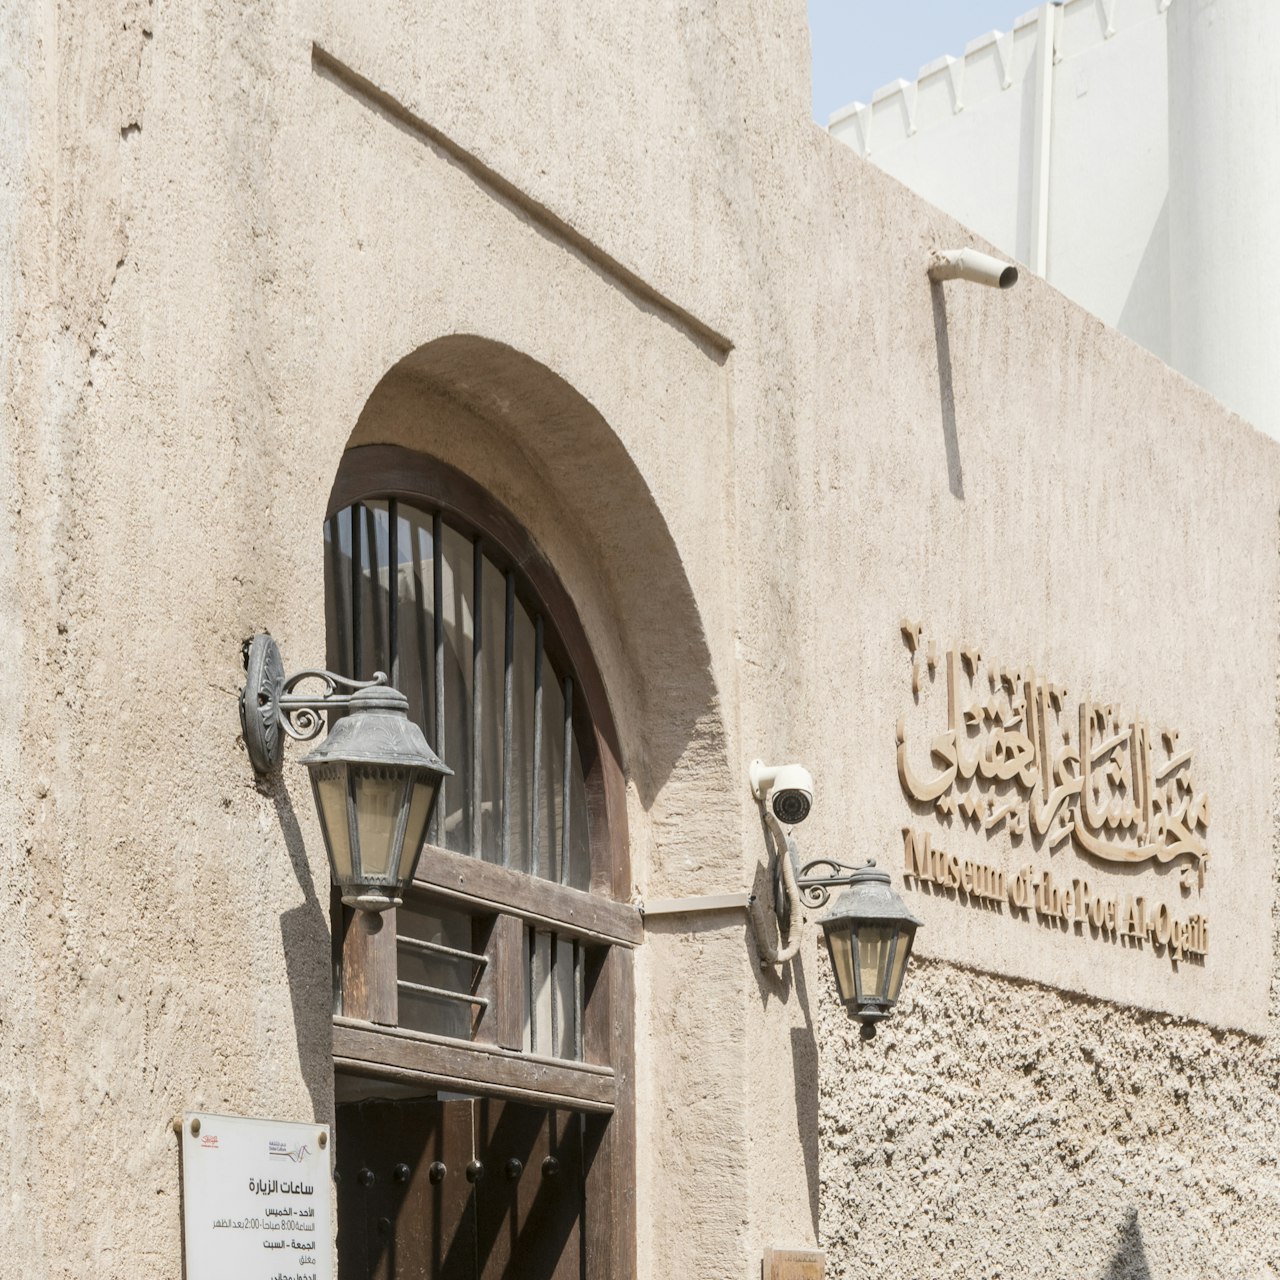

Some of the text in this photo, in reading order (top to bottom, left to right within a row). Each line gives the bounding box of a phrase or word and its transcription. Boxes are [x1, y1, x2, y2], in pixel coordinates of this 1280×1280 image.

[901, 827, 1007, 902] Museum
[1008, 863, 1033, 908] of
[1032, 871, 1074, 918] the
[1073, 878, 1119, 931] Poet
[249, 1178, 314, 1196] ساعات الزيارة
[265, 1207, 292, 1217] الخميس
[299, 1207, 315, 1217] الأحد
[213, 1219, 231, 1229] الظهر
[233, 1220, 244, 1230] بعد
[296, 1221, 315, 1231] الساعة
[263, 1240, 285, 1250] السبت
[291, 1239, 315, 1251] الجمعة
[299, 1255, 316, 1265] مغلق
